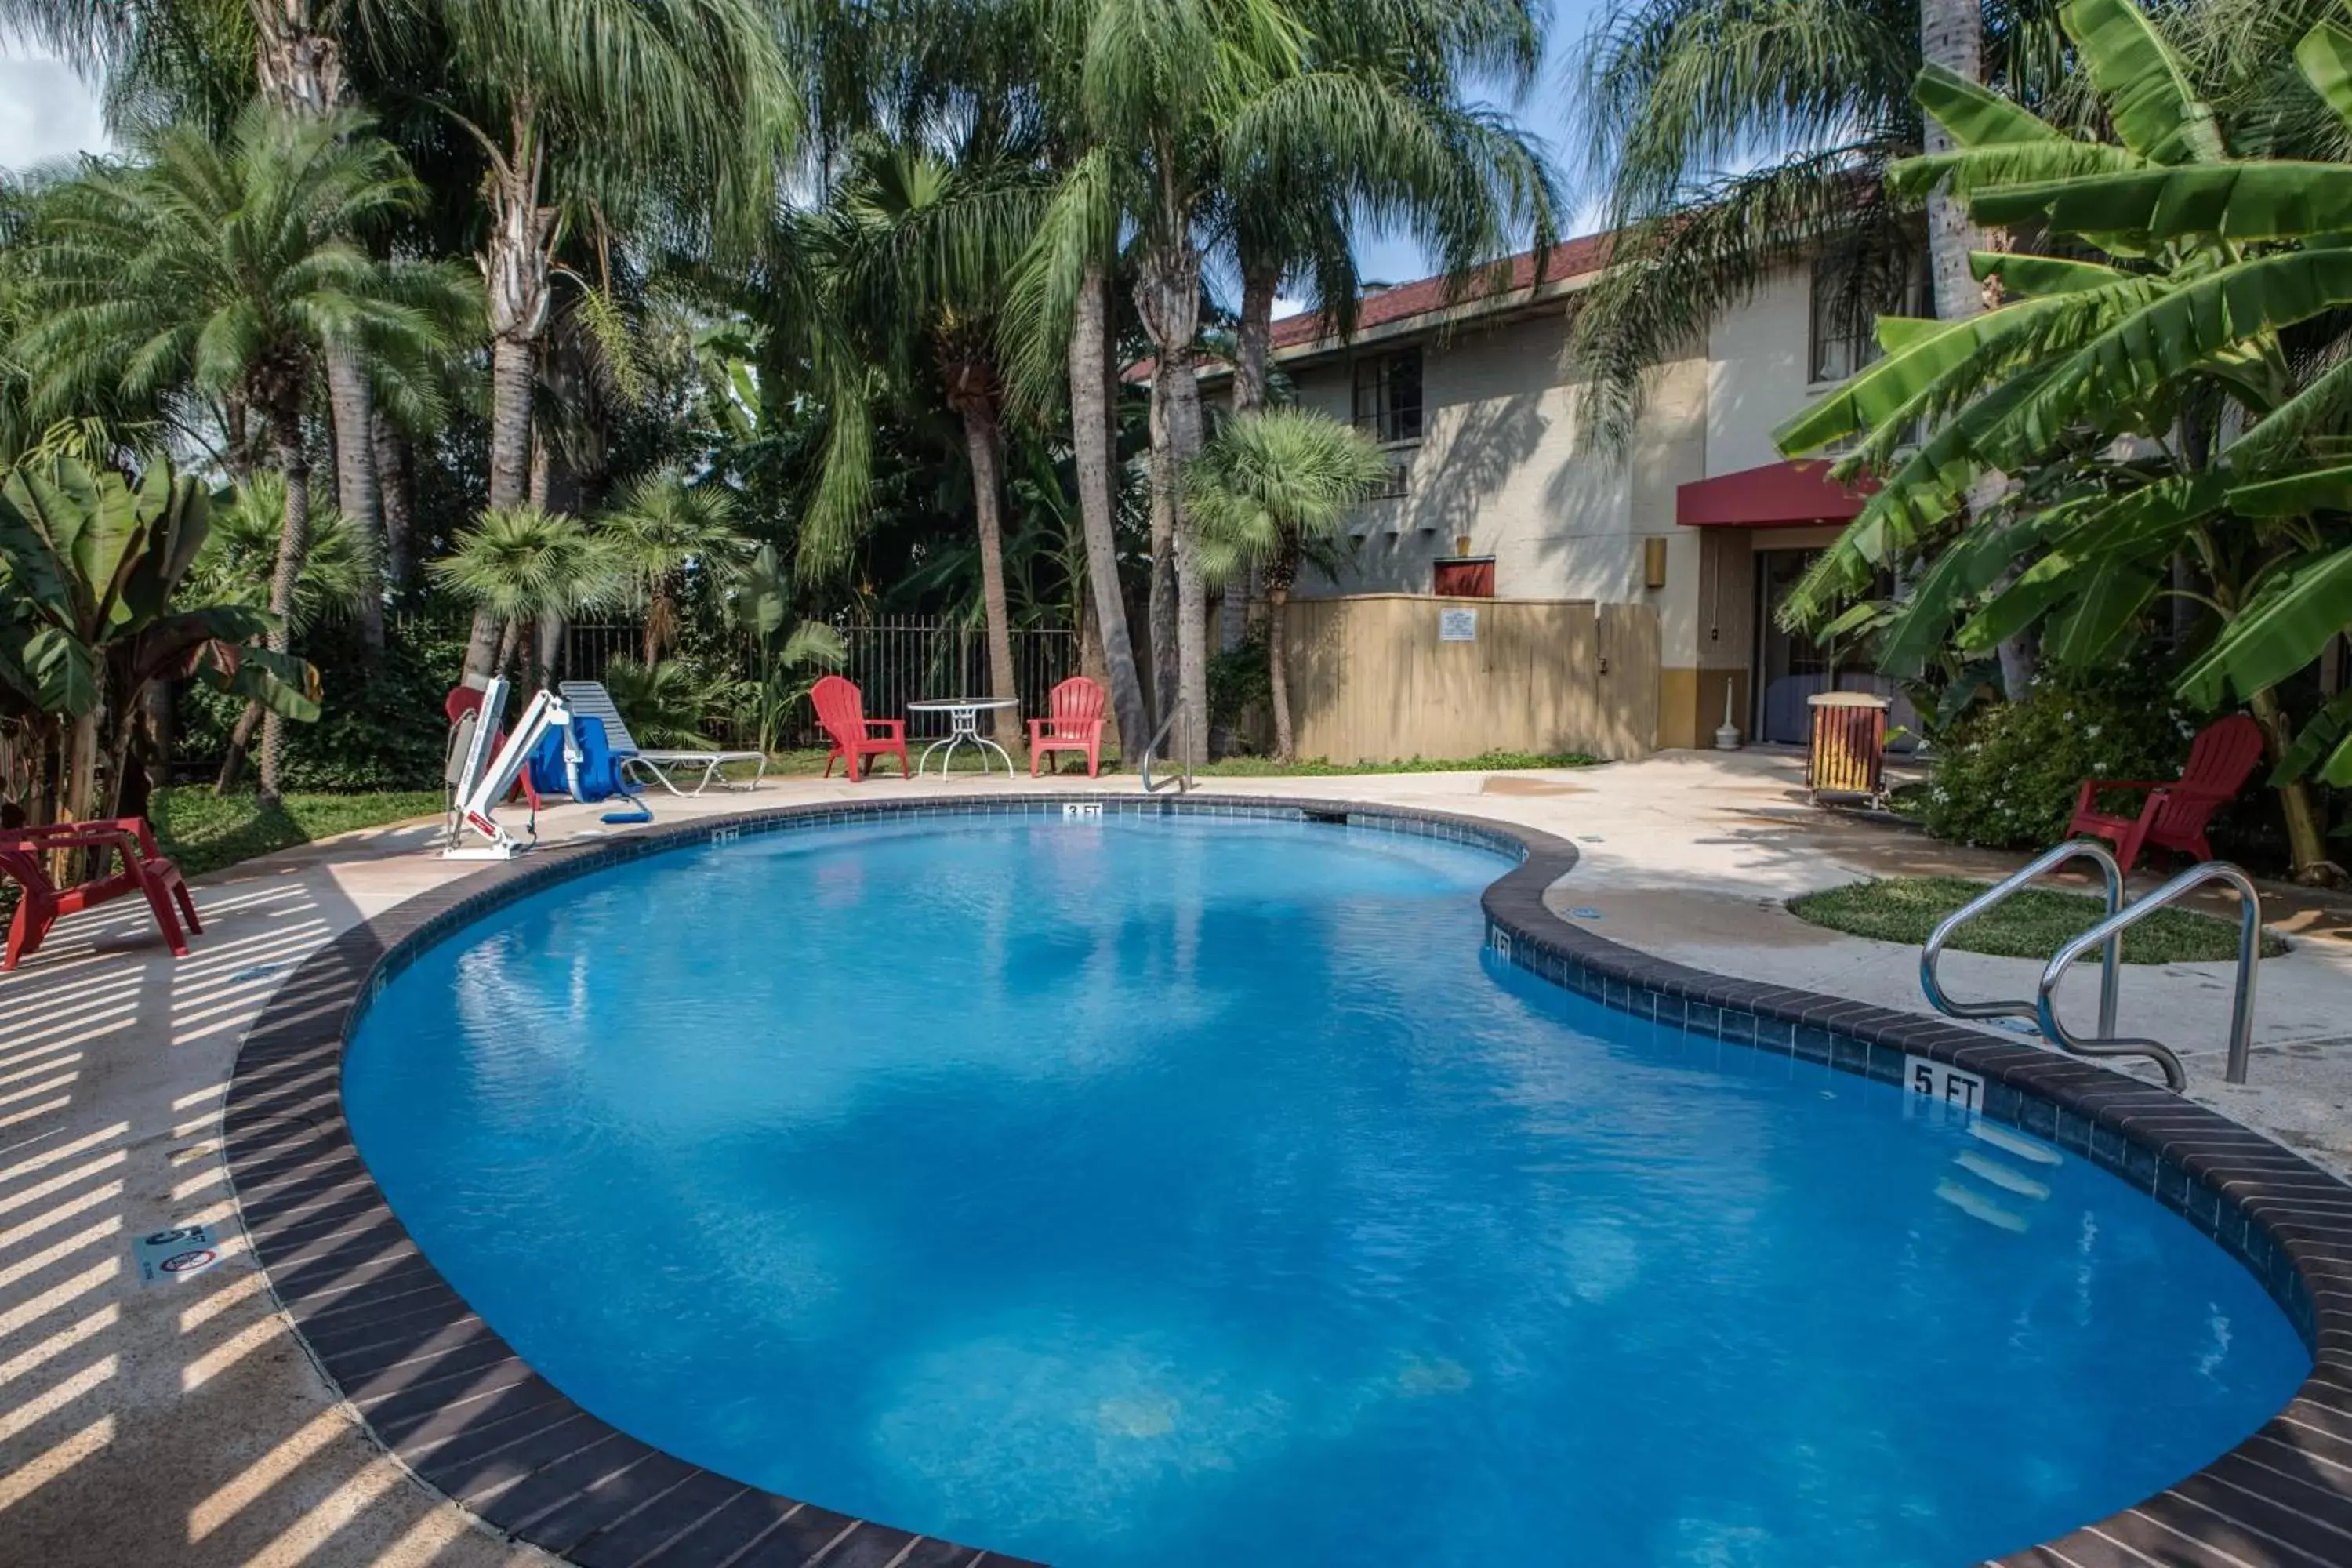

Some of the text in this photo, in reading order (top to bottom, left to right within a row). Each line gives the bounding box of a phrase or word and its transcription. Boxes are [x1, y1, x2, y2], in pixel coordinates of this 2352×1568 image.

[1084, 805, 1100, 815] FT
[1915, 1065, 1979, 1109] 5 FT
[146, 1226, 203, 1245] 5
